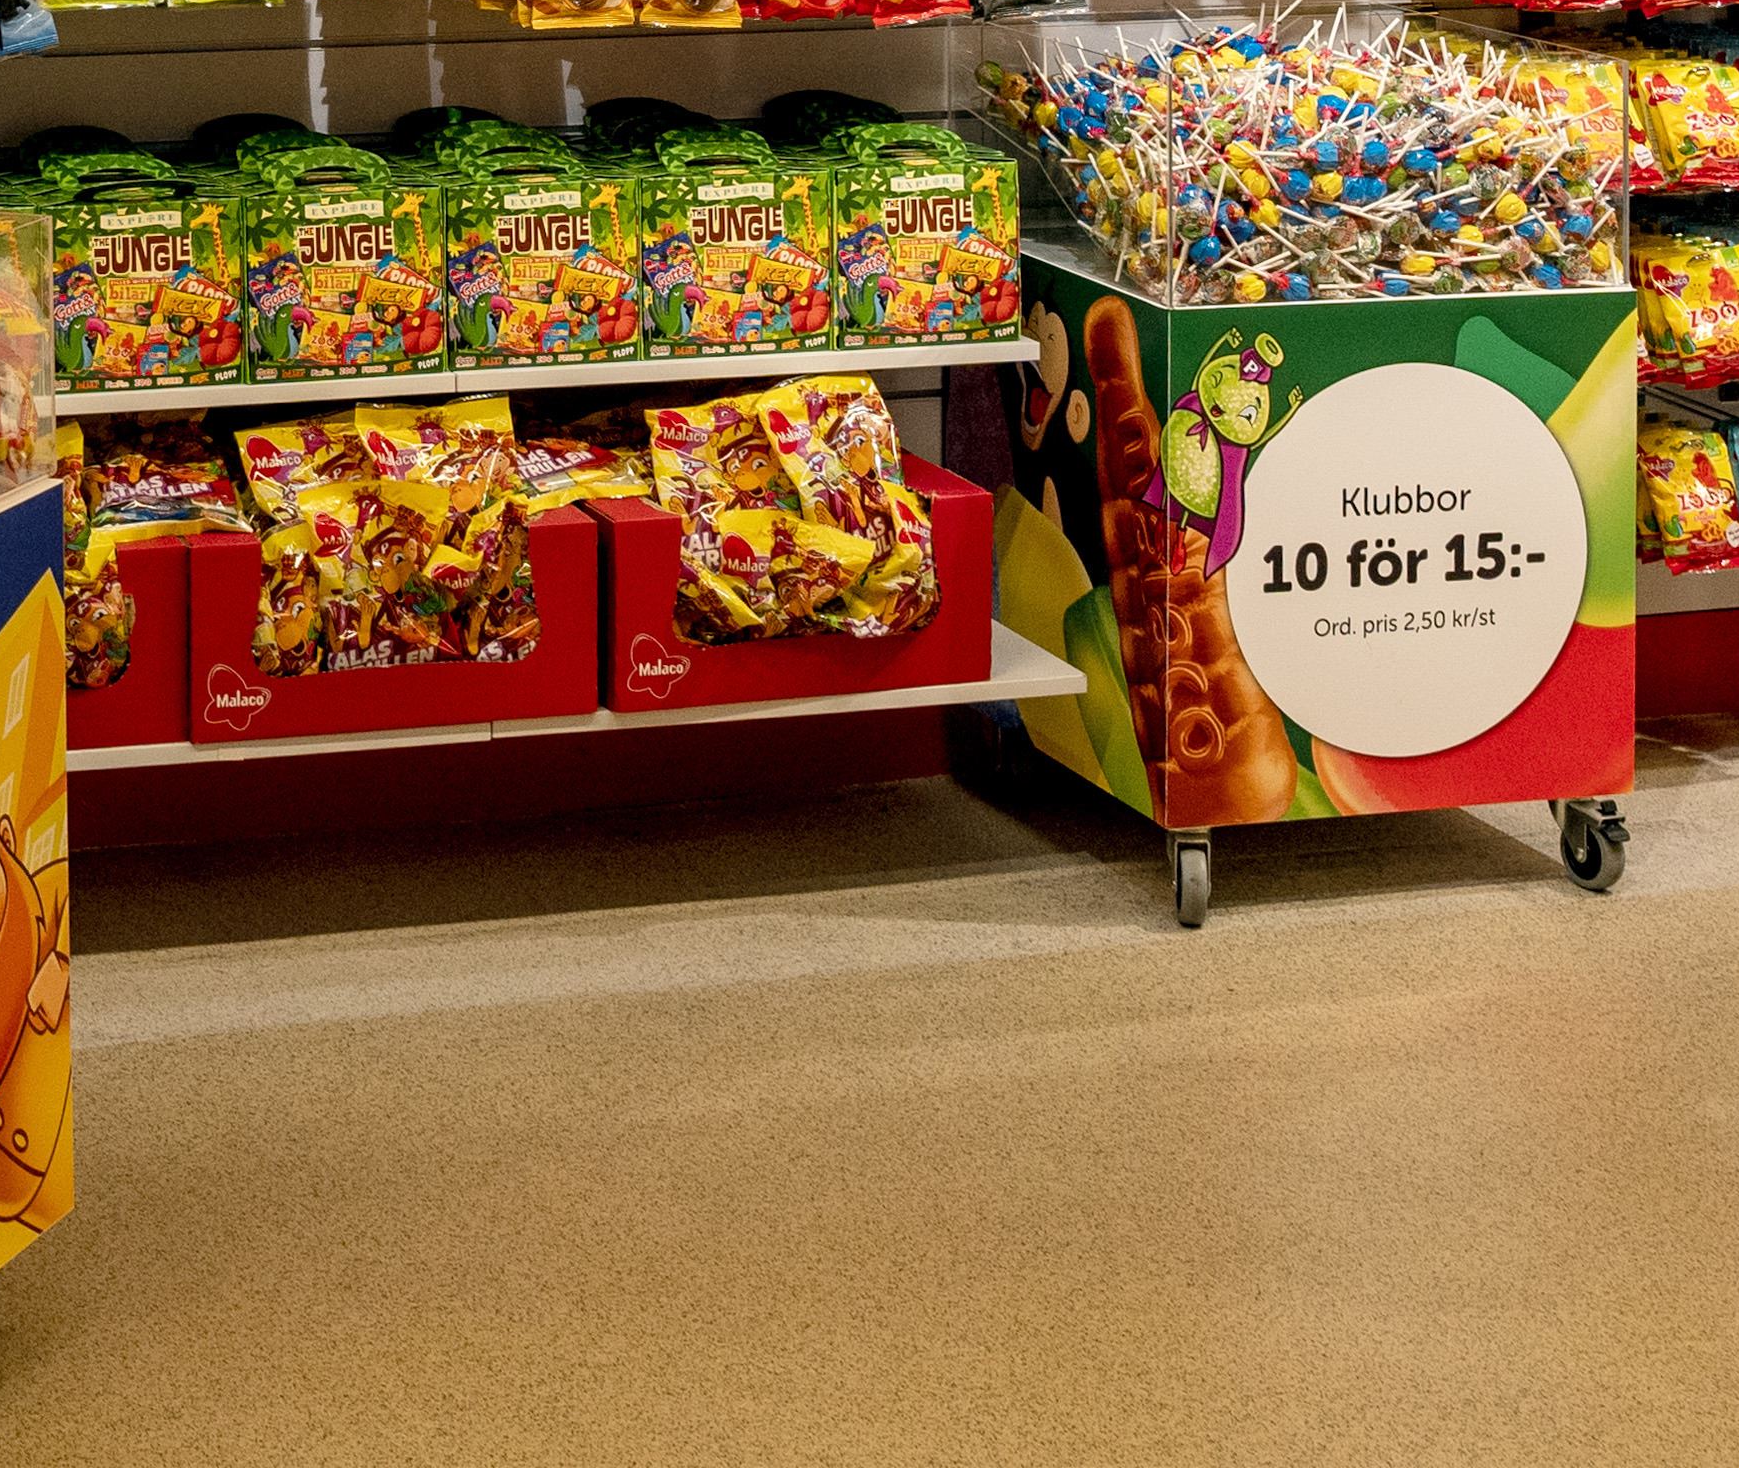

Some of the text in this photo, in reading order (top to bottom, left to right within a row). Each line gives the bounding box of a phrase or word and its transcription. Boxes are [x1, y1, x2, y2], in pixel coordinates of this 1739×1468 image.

[498, 217, 512, 226] THE
[692, 205, 783, 245] JUNGLE
[885, 197, 974, 236] JUNGLE
[298, 227, 313, 237] THE
[498, 214, 590, 253] JUNGLE
[300, 225, 393, 264] JUNGLE
[93, 236, 191, 274] JUNGLE
[513, 264, 549, 279] bilar
[313, 276, 351, 290] bilar
[109, 286, 149, 300] bilar
[994, 327, 1015, 337] PLOPP
[418, 356, 439, 369] PLOPP
[1245, 359, 1260, 375] P
[215, 369, 237, 381] PLOPP
[663, 425, 709, 443] Malaco
[256, 453, 302, 470] Malaco
[1342, 484, 1472, 517] Klubbor
[1262, 532, 1546, 593] 10 för 15:-
[1314, 608, 1496, 638] Ord. pris 2,50 kr/st
[639, 660, 683, 676] Malaco
[216, 692, 265, 709] Malaco
